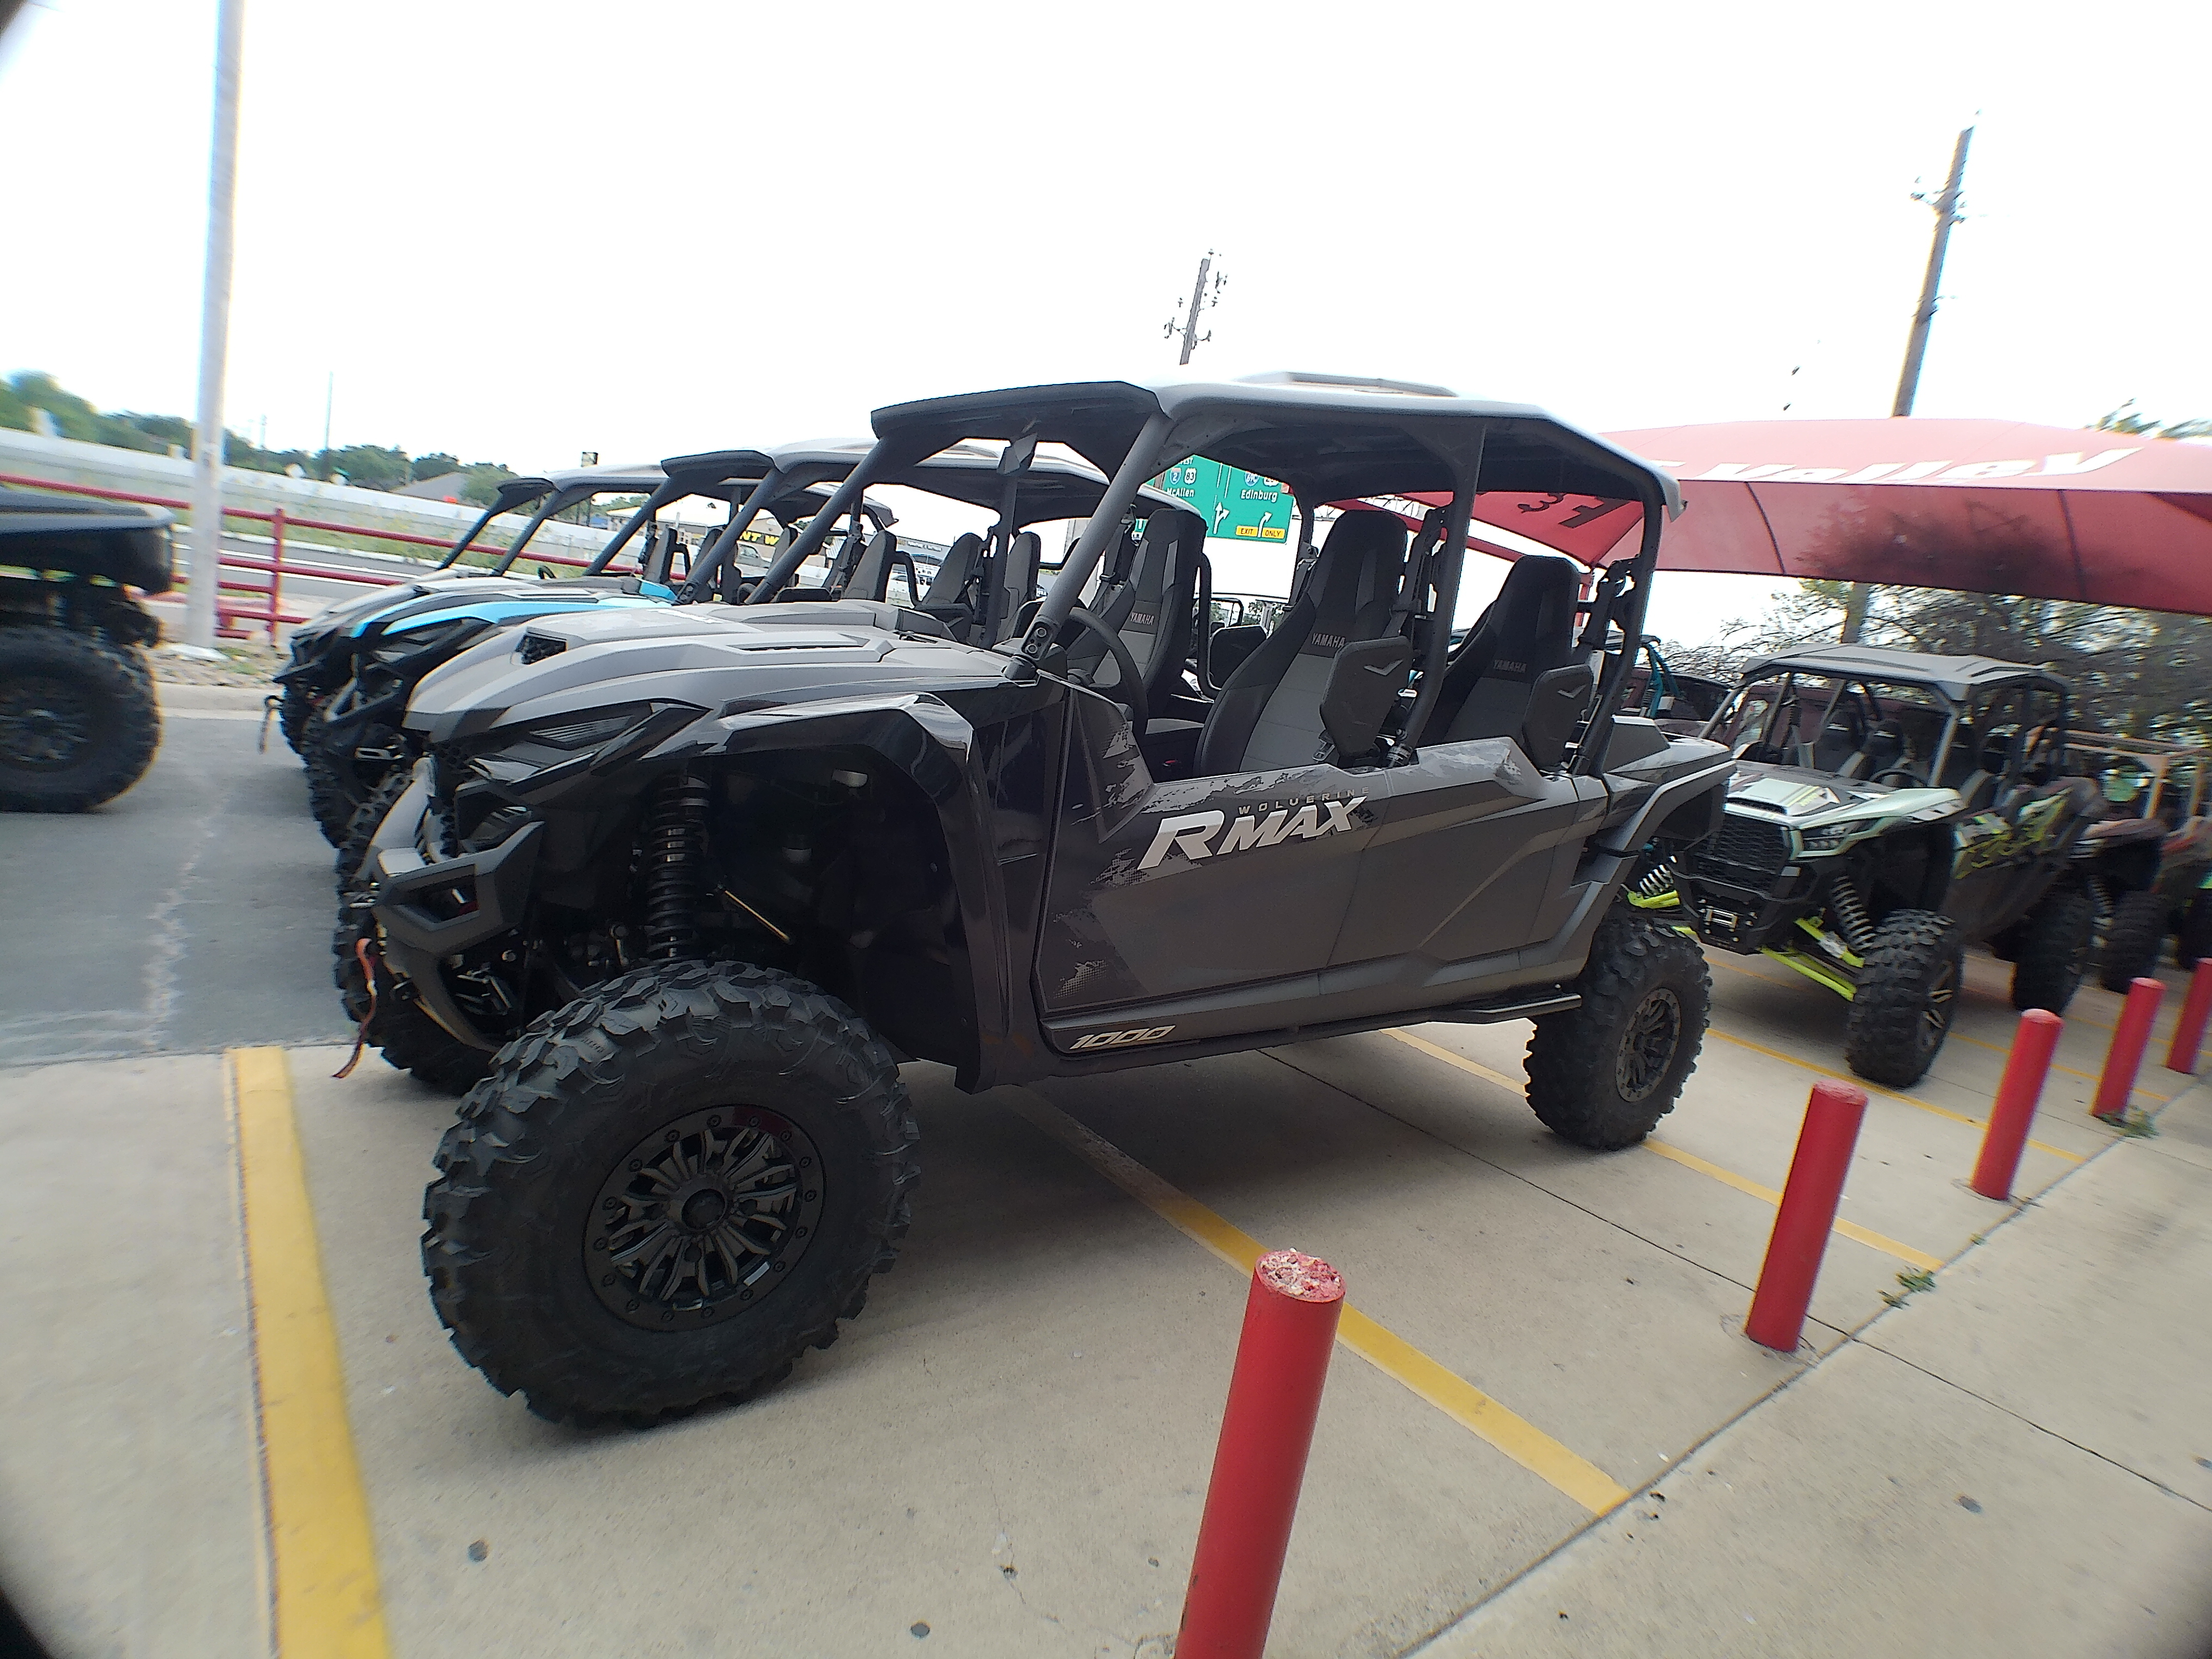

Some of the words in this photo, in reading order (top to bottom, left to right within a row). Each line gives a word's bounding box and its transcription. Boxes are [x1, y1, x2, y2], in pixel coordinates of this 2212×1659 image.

[1694, 446, 2144, 483] Valley
[1172, 472, 1178, 481] 2
[1186, 472, 1195, 480] 83
[1167, 487, 1195, 497] McAllen
[1241, 489, 1278, 502] Edinburg
[1131, 612, 1154, 625] YAMAHA
[1311, 633, 1346, 648] YAMAHA
[1069, 1025, 1177, 1050] 1000
